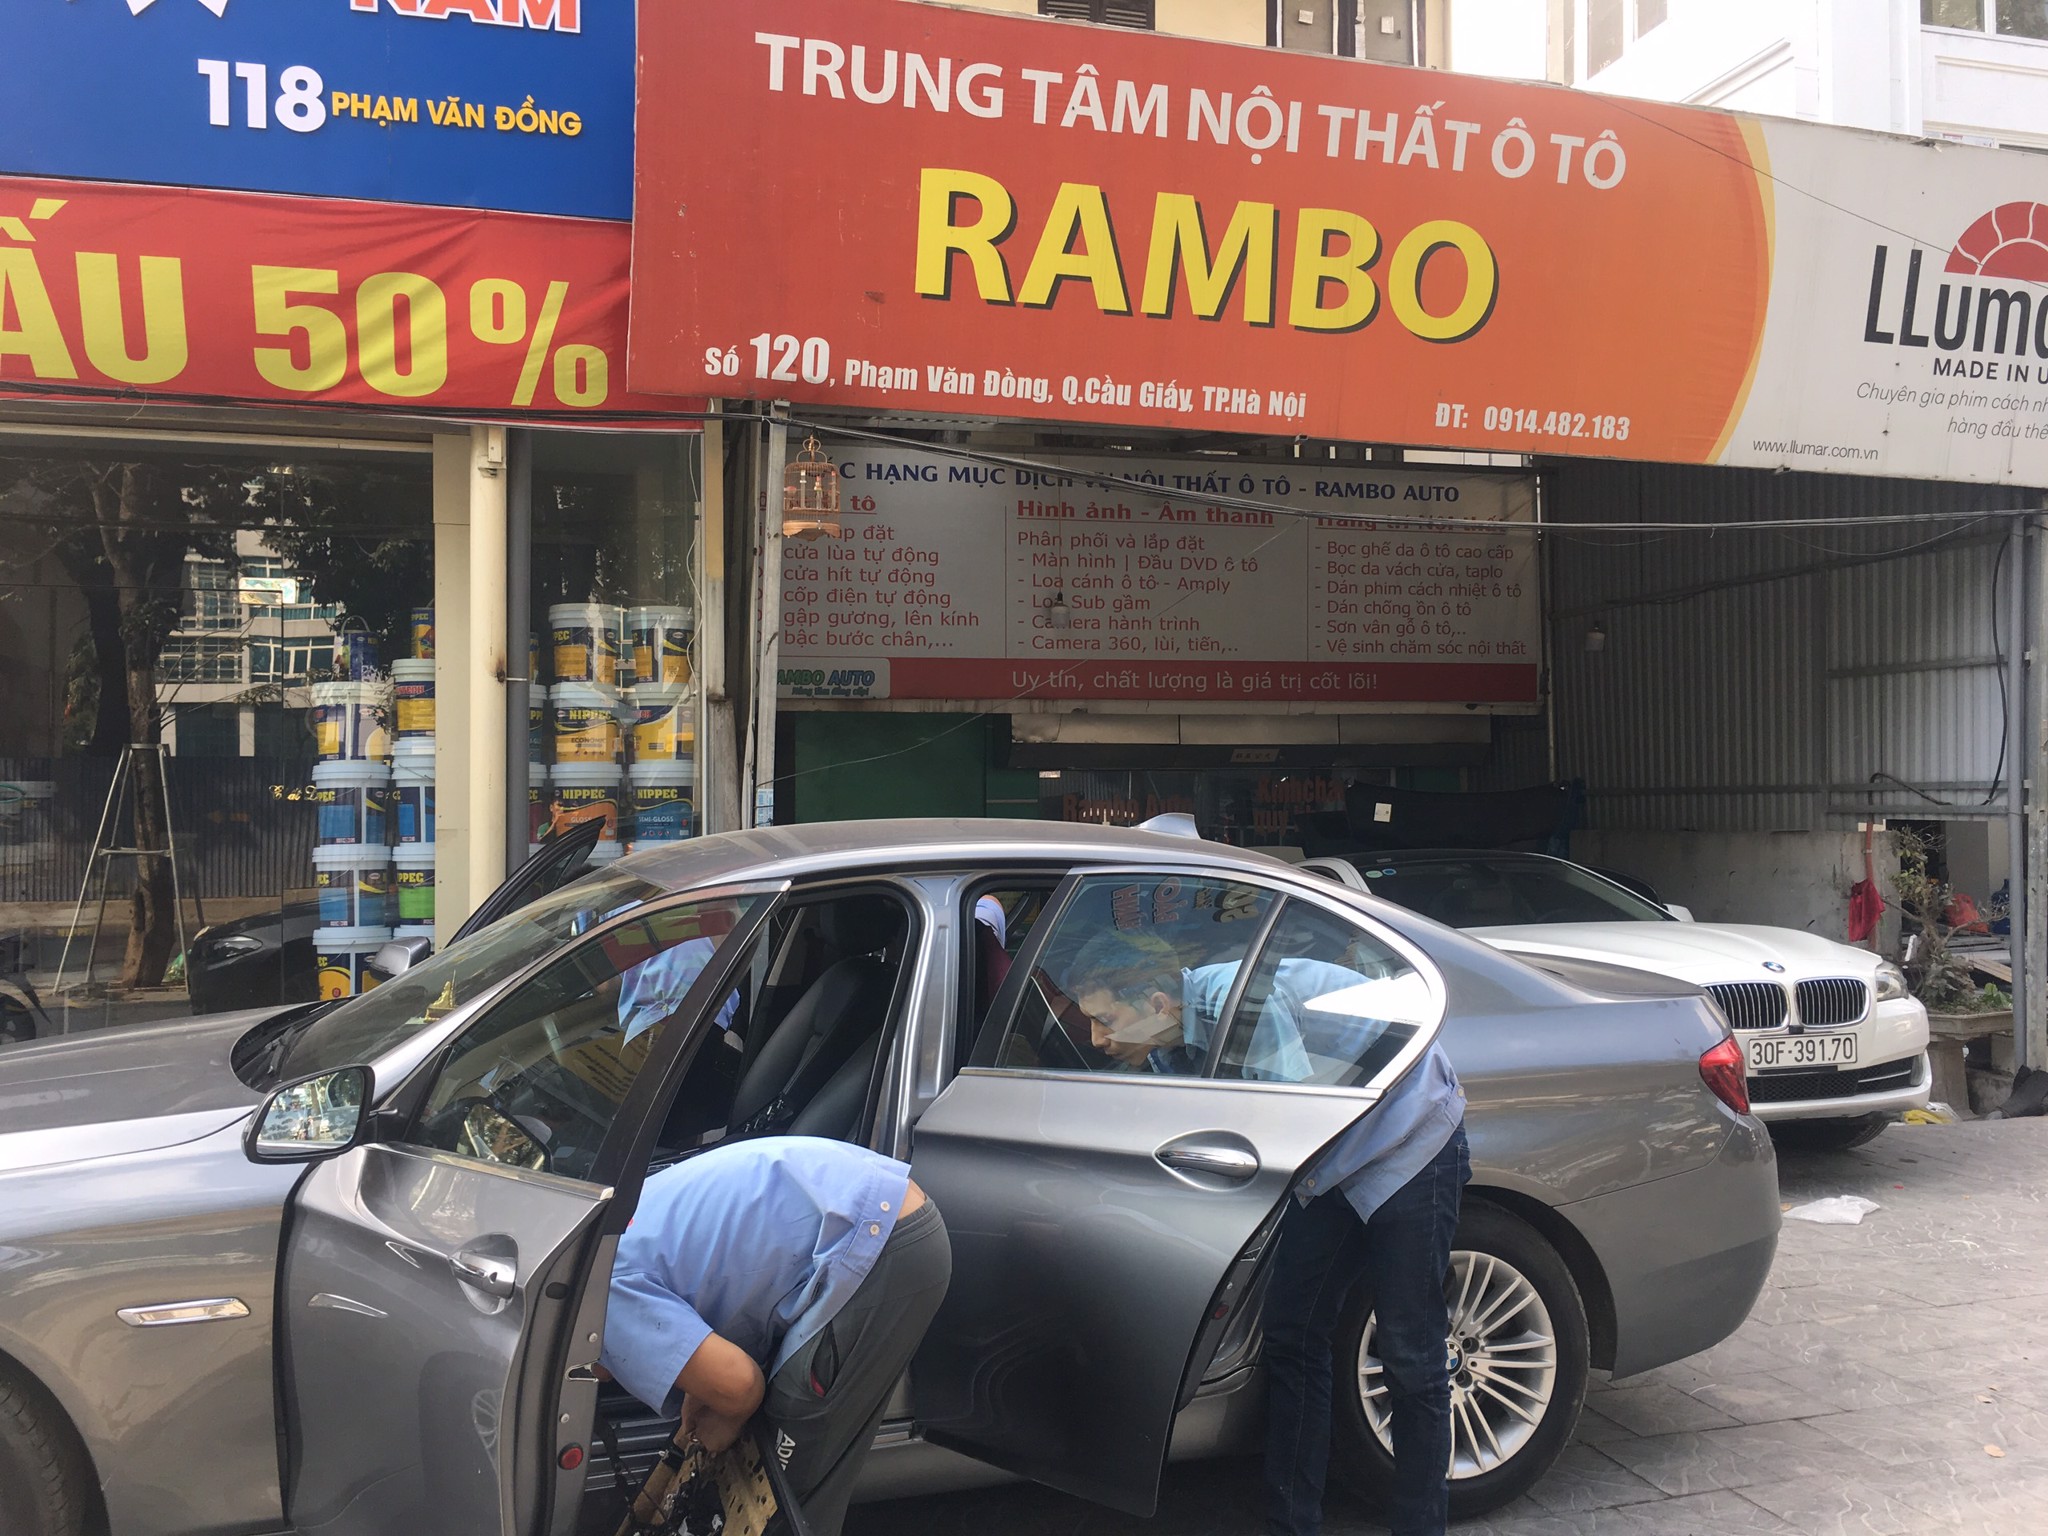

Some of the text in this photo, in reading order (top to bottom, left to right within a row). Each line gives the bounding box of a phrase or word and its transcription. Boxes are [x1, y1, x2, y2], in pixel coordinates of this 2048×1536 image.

[197, 58, 583, 136] 118 PHẠM VĂN ĐỒNG
[755, 32, 1626, 190] TRUNG TÂM NỘI THẤT Ô TÔ
[915, 168, 1499, 344] RAMBO
[704, 333, 1306, 422] Số 120, Phạm Văn Đồng, Q.Cầu Giấy, TP.Hà Nội
[1933, 358, 1999, 380] MADE
[2007, 364, 2029, 383] IN
[1856, 382, 1916, 405] Chuyên
[1919, 388, 1945, 408] gia
[1947, 390, 1988, 409] phim
[1991, 393, 2029, 412] cách
[1435, 402, 1630, 441] ĐT: 0914.482.183
[1947, 417, 2021, 439] hàng đầu
[1753, 440, 1879, 460] www.llumar.com.vn
[866, 463, 937, 485] HẠNG
[948, 466, 1006, 488] MỤC
[1172, 470, 1231, 493] THẤT
[1239, 473, 1254, 494] Ô
[1262, 475, 1290, 495] TÔ
[1315, 481, 1395, 499] RAMBO
[1403, 485, 1459, 502] AUTO
[851, 495, 876, 511] tô
[1017, 499, 1274, 525] Hình ảnh Âm thanh
[863, 525, 894, 543] đặt
[1018, 531, 1205, 553] Phân phối và lắp đặt
[784, 544, 939, 566] cửa lùa tự động
[1327, 541, 1356, 558] Bọc
[1396, 544, 1414, 556] da
[1420, 543, 1430, 557] ô
[1435, 543, 1450, 557] tô
[1456, 548, 1482, 559] cao
[1488, 545, 1514, 562] cấp
[1032, 552, 1069, 567] Màn
[1077, 554, 1116, 569] hình
[1137, 555, 1173, 570] Đầu
[1180, 557, 1218, 571] DVD
[1241, 557, 1258, 572] tô
[1327, 561, 1503, 581] Bọc da vách cửa, taplo
[784, 565, 935, 587] cửa hít tự động
[1032, 574, 1063, 588] Loa
[1071, 574, 1114, 589] cánh
[1121, 574, 1132, 589] ô
[1176, 577, 1231, 594] Amply
[784, 586, 951, 608] cốp điện tự động
[1327, 579, 1522, 599] Dán phim cách nhiệt ô tô
[1032, 594, 1150, 613] Lo Sub gầm
[1327, 599, 1357, 614] Dán
[1364, 600, 1411, 617] chống
[1441, 601, 1451, 615] ô
[1456, 602, 1472, 616] tô
[784, 608, 979, 628] gập gương, lên kính
[1108, 616, 1152, 631] hành
[1159, 616, 1200, 631] trình
[1327, 620, 1357, 634] Sơn
[1363, 620, 1390, 634] vân
[1420, 620, 1430, 635] ô
[784, 631, 818, 647] bậc
[826, 631, 874, 646] bước
[1032, 635, 1101, 650] Camera
[1108, 636, 1147, 653] 360,
[1327, 639, 1527, 657] Vệ sinh chăm sóc nội thất
[777, 669, 875, 686] AMBO AUTO
[1012, 671, 1040, 692] Uy
[1093, 670, 1140, 689] chất
[1148, 671, 1207, 692] lượng
[1216, 671, 1234, 689] là
[1242, 671, 1272, 693] giá
[1280, 672, 1301, 694] trị
[1310, 671, 1341, 690] cốt
[563, 789, 606, 799] NIPPEC
[637, 789, 678, 799] NIPPEC
[1752, 1037, 1854, 1066] 30F-391.70
